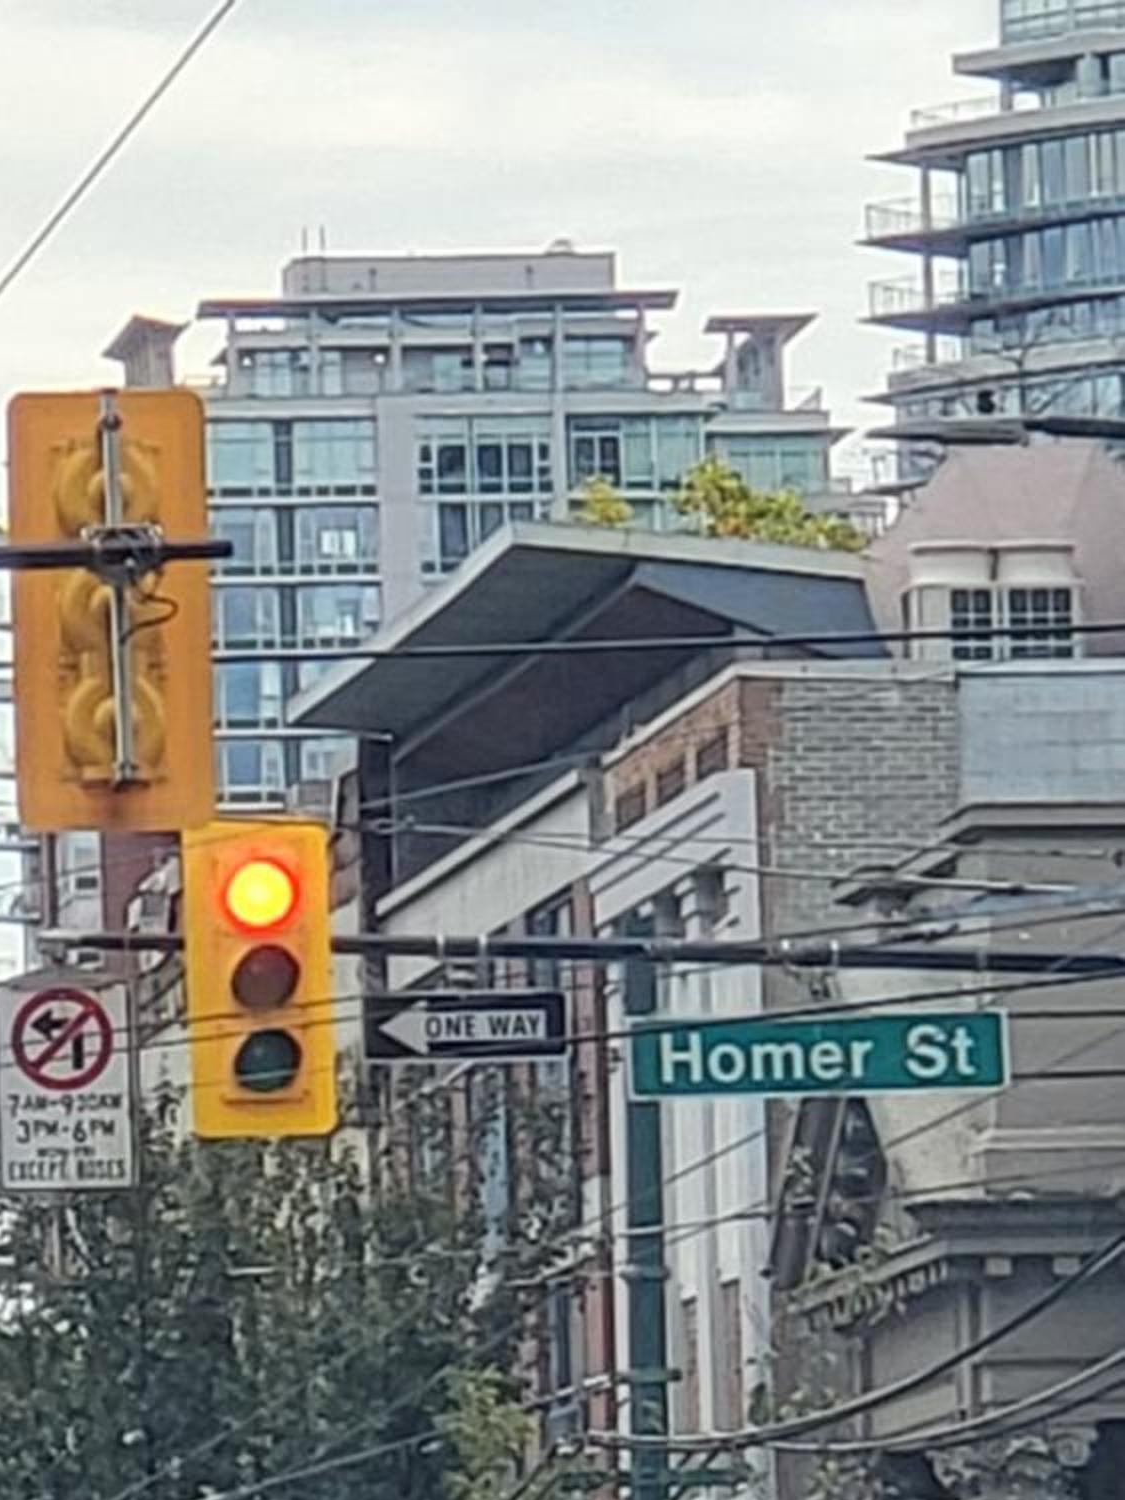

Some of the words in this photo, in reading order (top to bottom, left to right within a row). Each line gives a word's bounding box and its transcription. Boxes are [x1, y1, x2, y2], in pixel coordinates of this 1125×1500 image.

[426, 1014, 476, 1038] ONE
[488, 1013, 541, 1037] WAY
[659, 1030, 875, 1084] Homer
[905, 1023, 976, 1079] St
